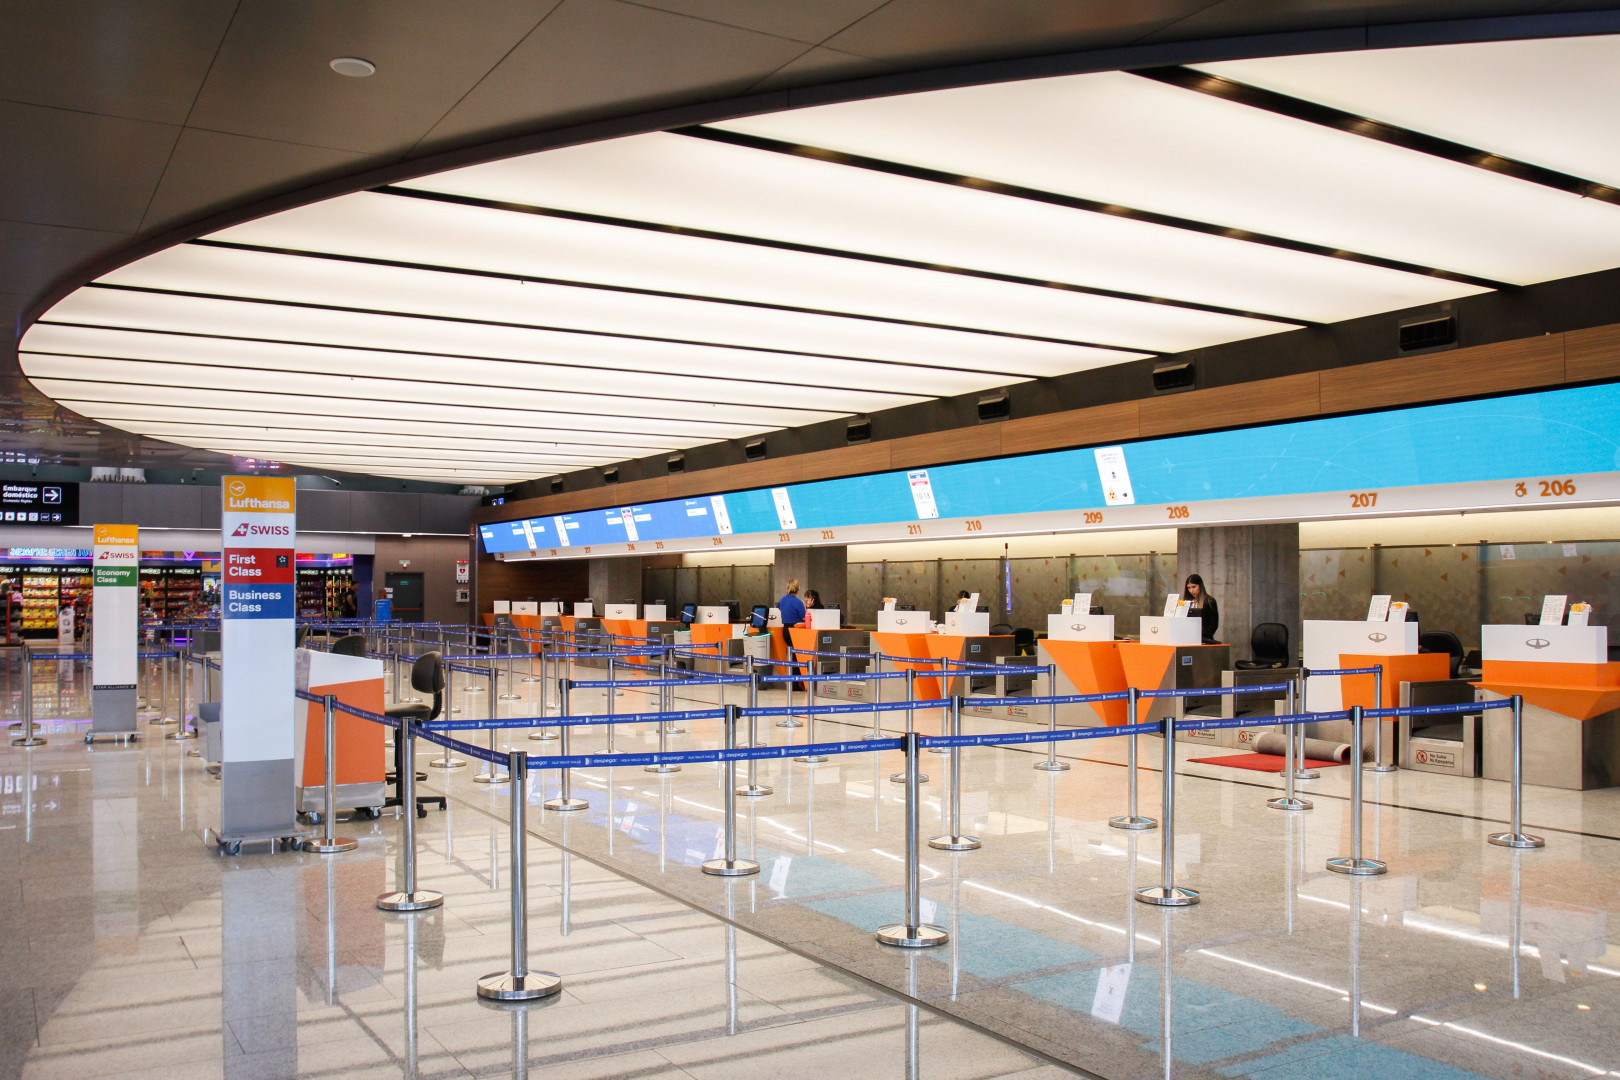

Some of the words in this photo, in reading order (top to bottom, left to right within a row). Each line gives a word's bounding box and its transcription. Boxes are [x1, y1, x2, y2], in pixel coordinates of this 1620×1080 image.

[1538, 479, 1576, 496] 206
[230, 498, 290, 509] Lufthansa
[1350, 493, 1378, 508] 207
[1166, 506, 1190, 518] 208
[1083, 512, 1103, 524] 209
[908, 525, 922, 534] 211
[965, 520, 982, 531] 210
[250, 526, 290, 536] SWISS
[822, 530, 834, 540] 212
[712, 538, 722, 546] 214
[779, 534, 790, 542] 213
[229, 554, 256, 564] First
[228, 566, 262, 576] Class
[229, 590, 282, 600] Business
[228, 602, 262, 612] Class
